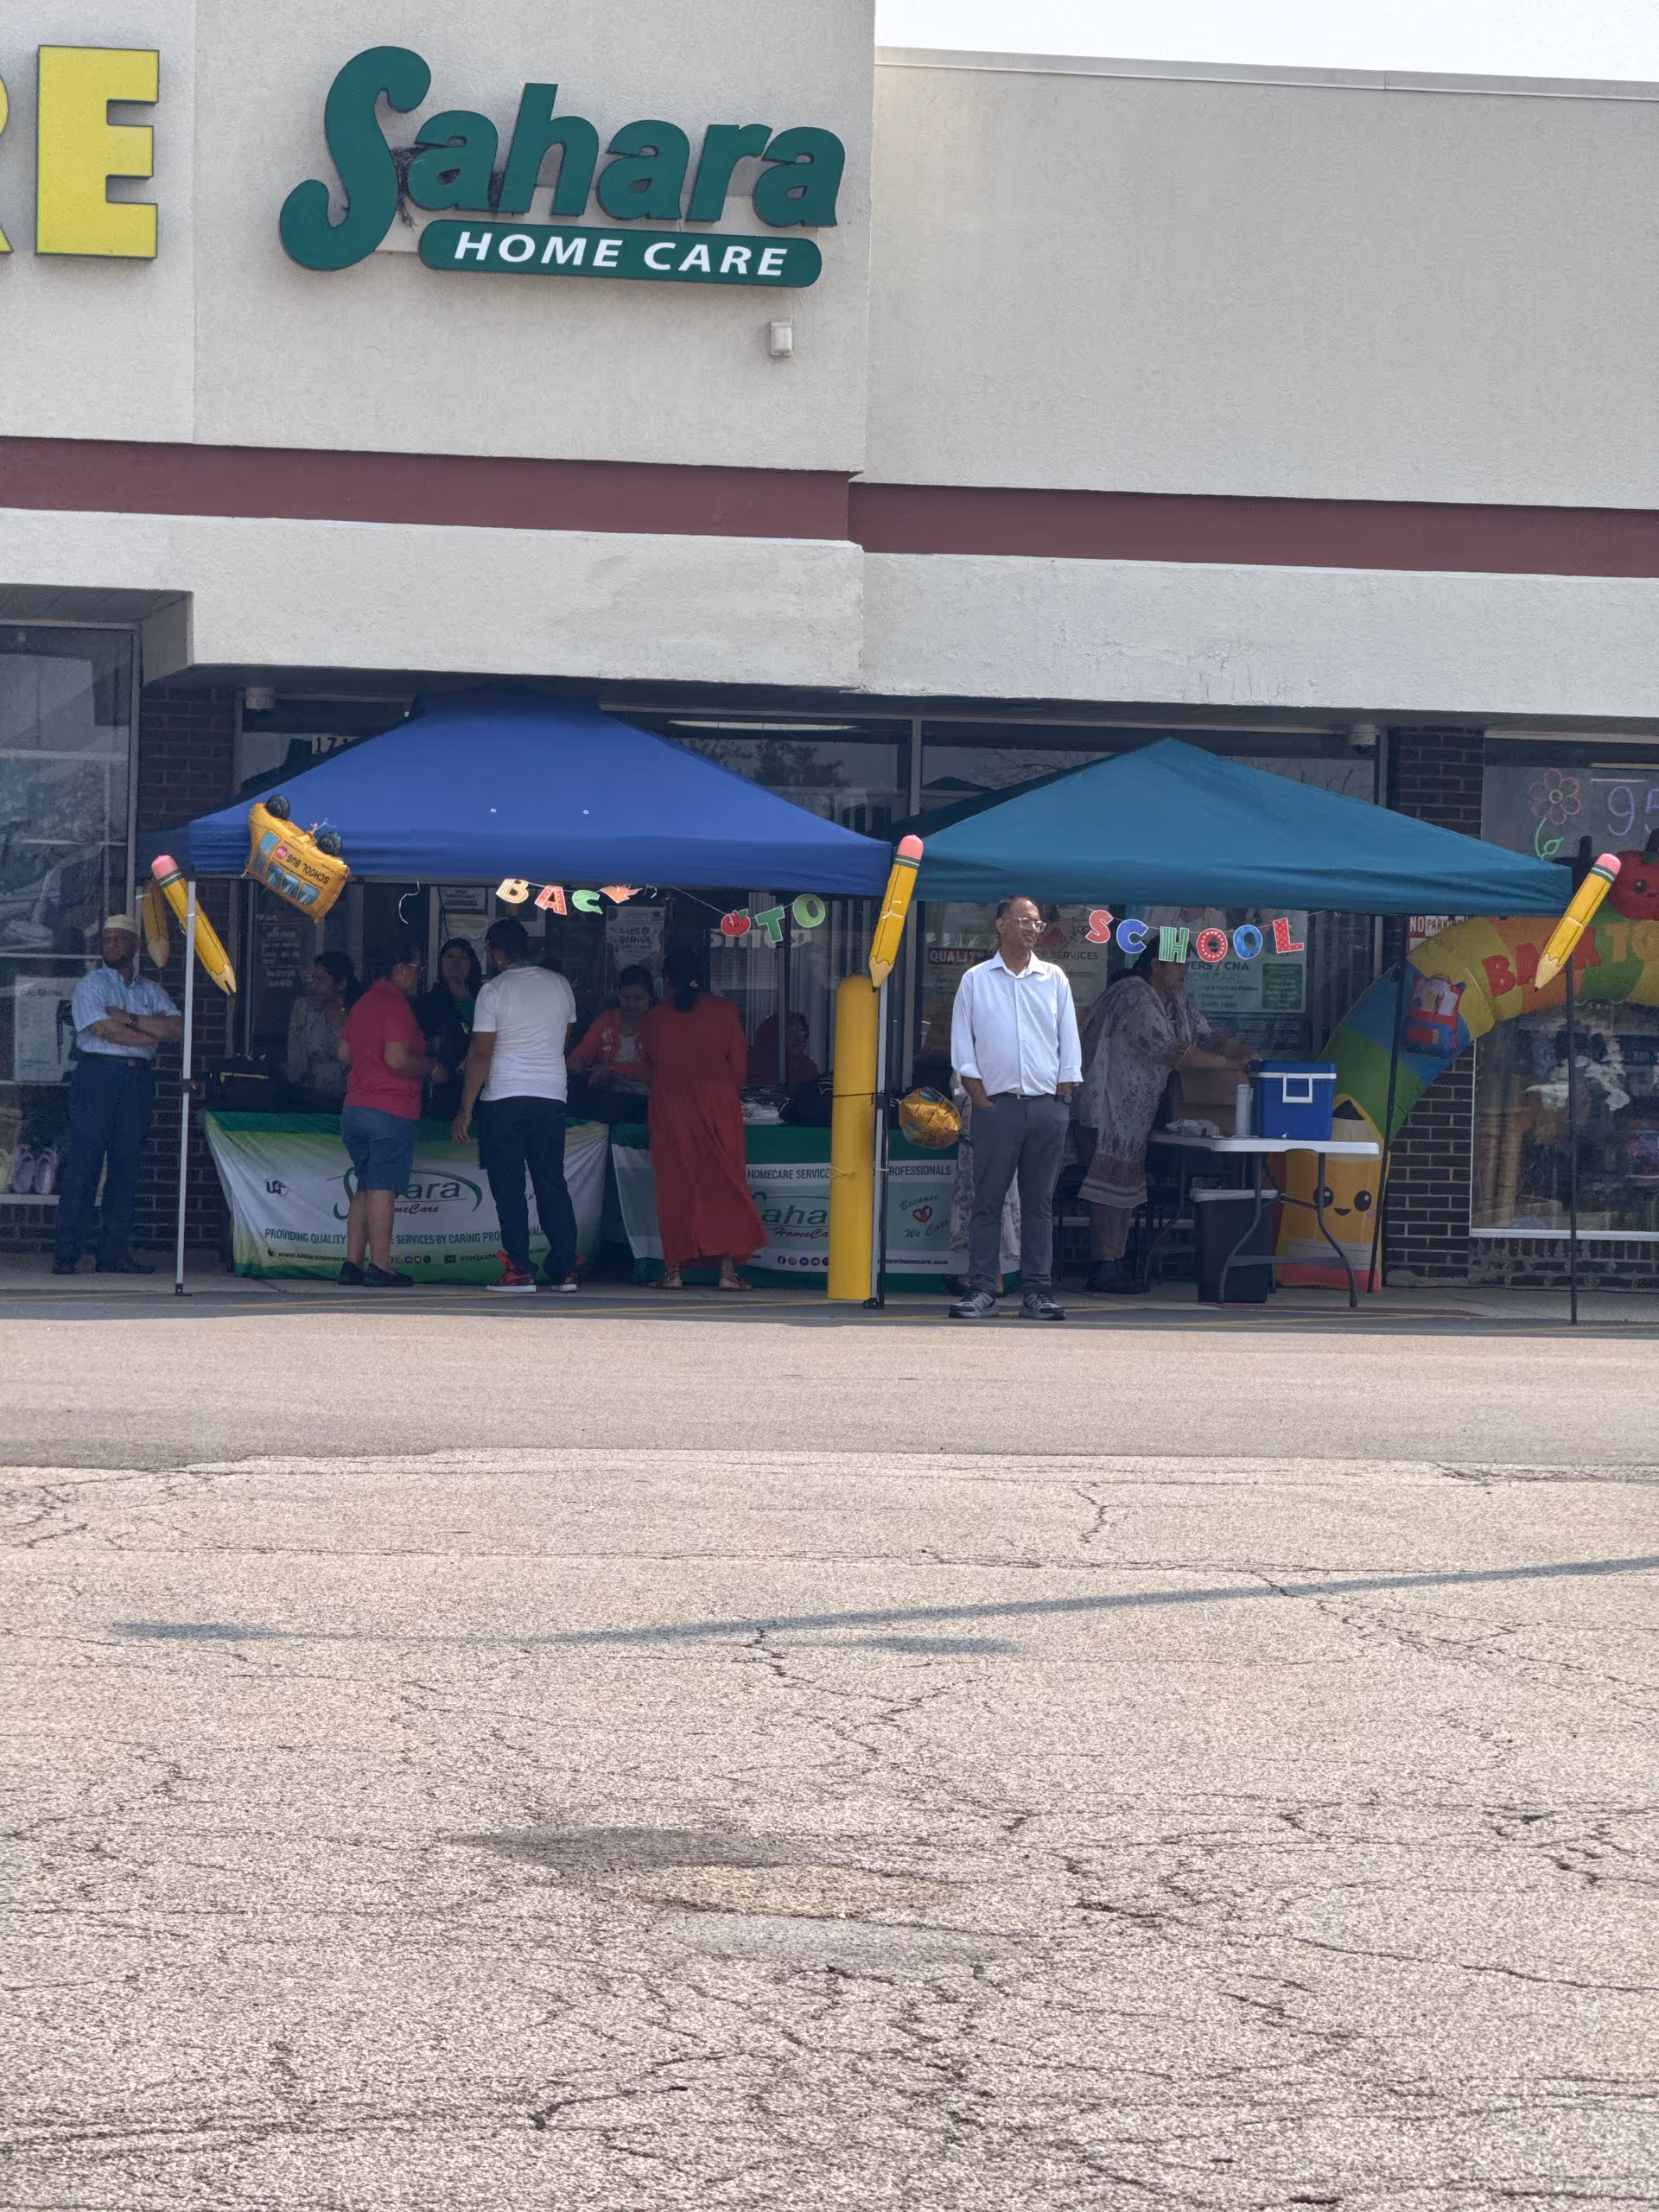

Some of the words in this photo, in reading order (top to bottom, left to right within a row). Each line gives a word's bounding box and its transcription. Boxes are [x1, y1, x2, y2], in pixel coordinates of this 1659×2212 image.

[280, 45, 847, 273] Sahara
[454, 231, 623, 268] HOME
[643, 240, 790, 276] CARE
[315, 736, 349, 753] 17
[286, 854, 302, 868] BUS
[302, 862, 330, 885] SCHOOL
[754, 893, 826, 944] TO
[1409, 915, 1425, 933] NO
[1085, 908, 1305, 963] SCHOOL
[1050, 950, 1099, 961] SERVICES
[1224, 962, 1250, 971] CNA
[748, 1168, 795, 1180] HOMECARE
[796, 1167, 830, 1179] SERVICE
[888, 1165, 951, 1176] ROFESSIONALS
[264, 1228, 308, 1243] PROVIDING
[310, 1233, 346, 1245] QUALITY
[396, 1233, 435, 1245] SERVICES
[435, 1233, 447, 1245] BY
[449, 1232, 481, 1244] CARING
